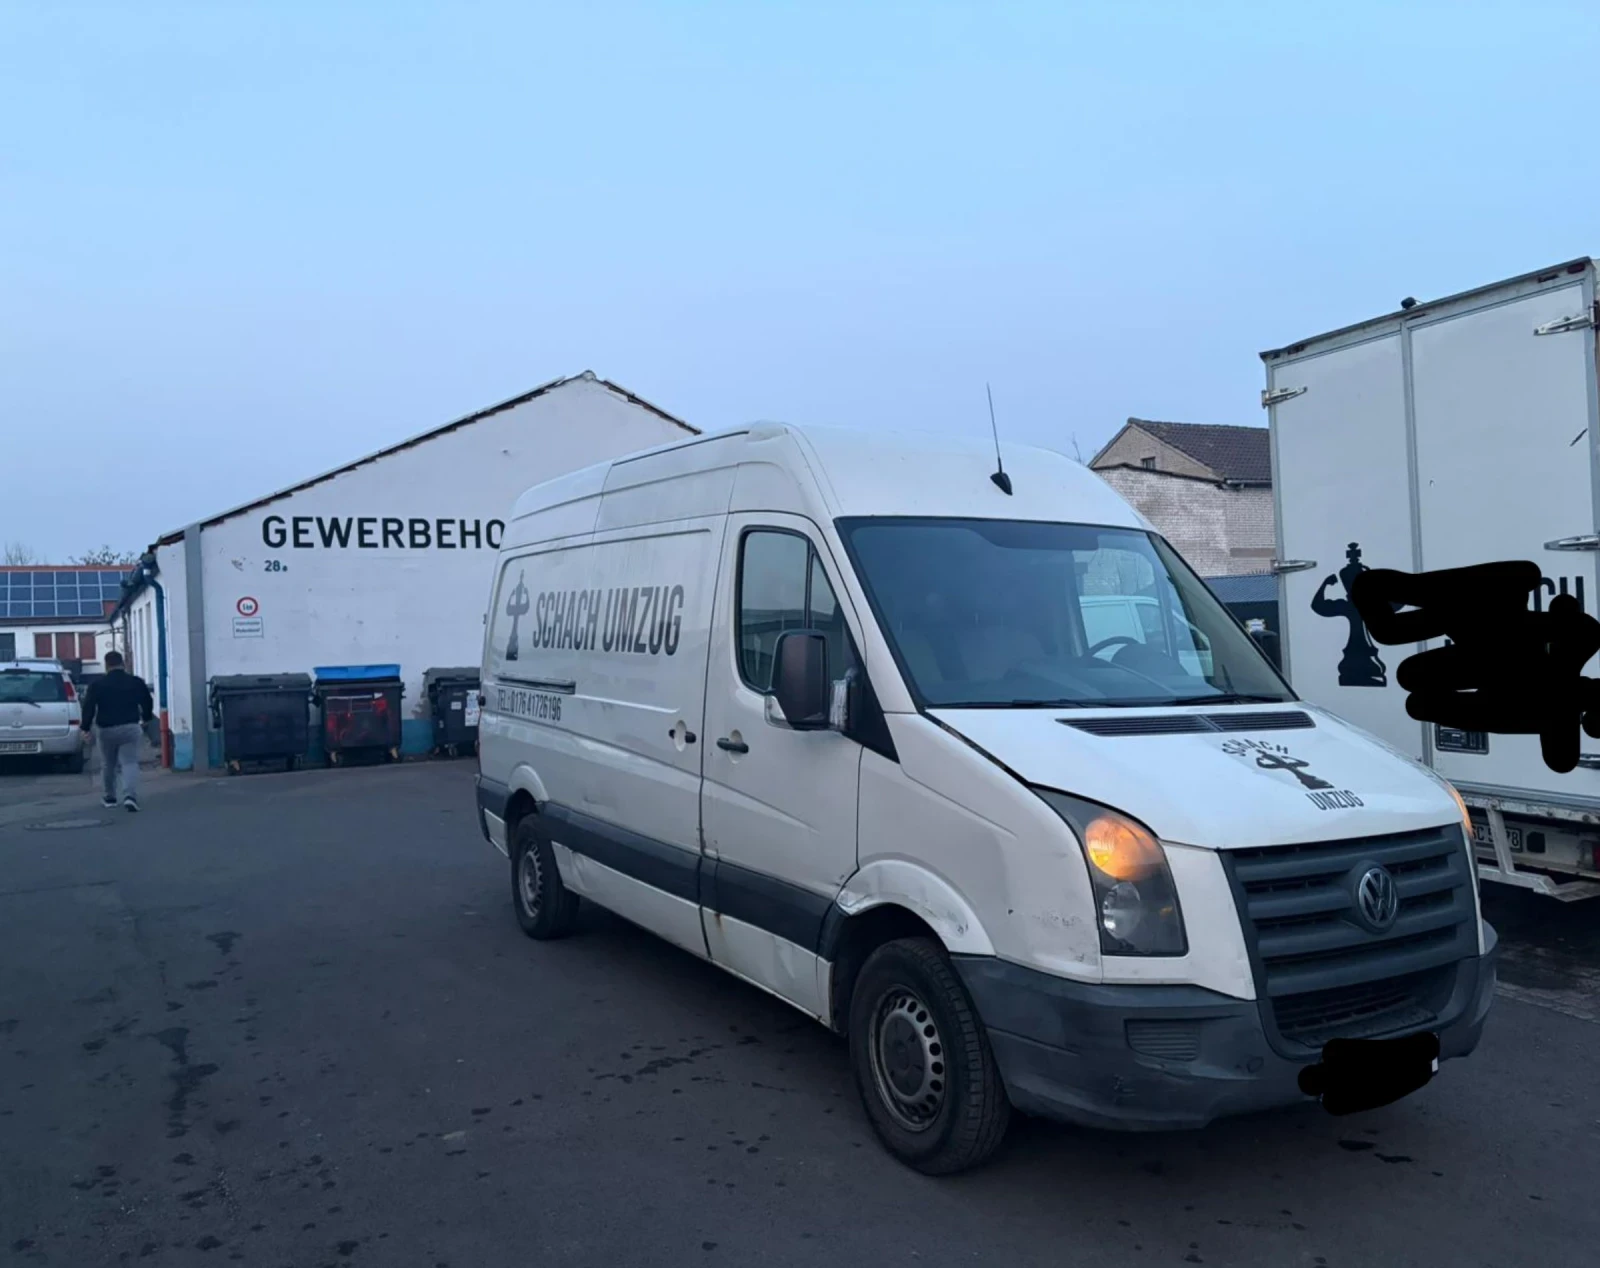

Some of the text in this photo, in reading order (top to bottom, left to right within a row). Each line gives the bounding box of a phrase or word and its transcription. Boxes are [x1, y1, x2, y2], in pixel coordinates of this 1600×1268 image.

[533, 584, 685, 656] SCHACH UMZUG
[1305, 789, 1365, 811] UMZUG
